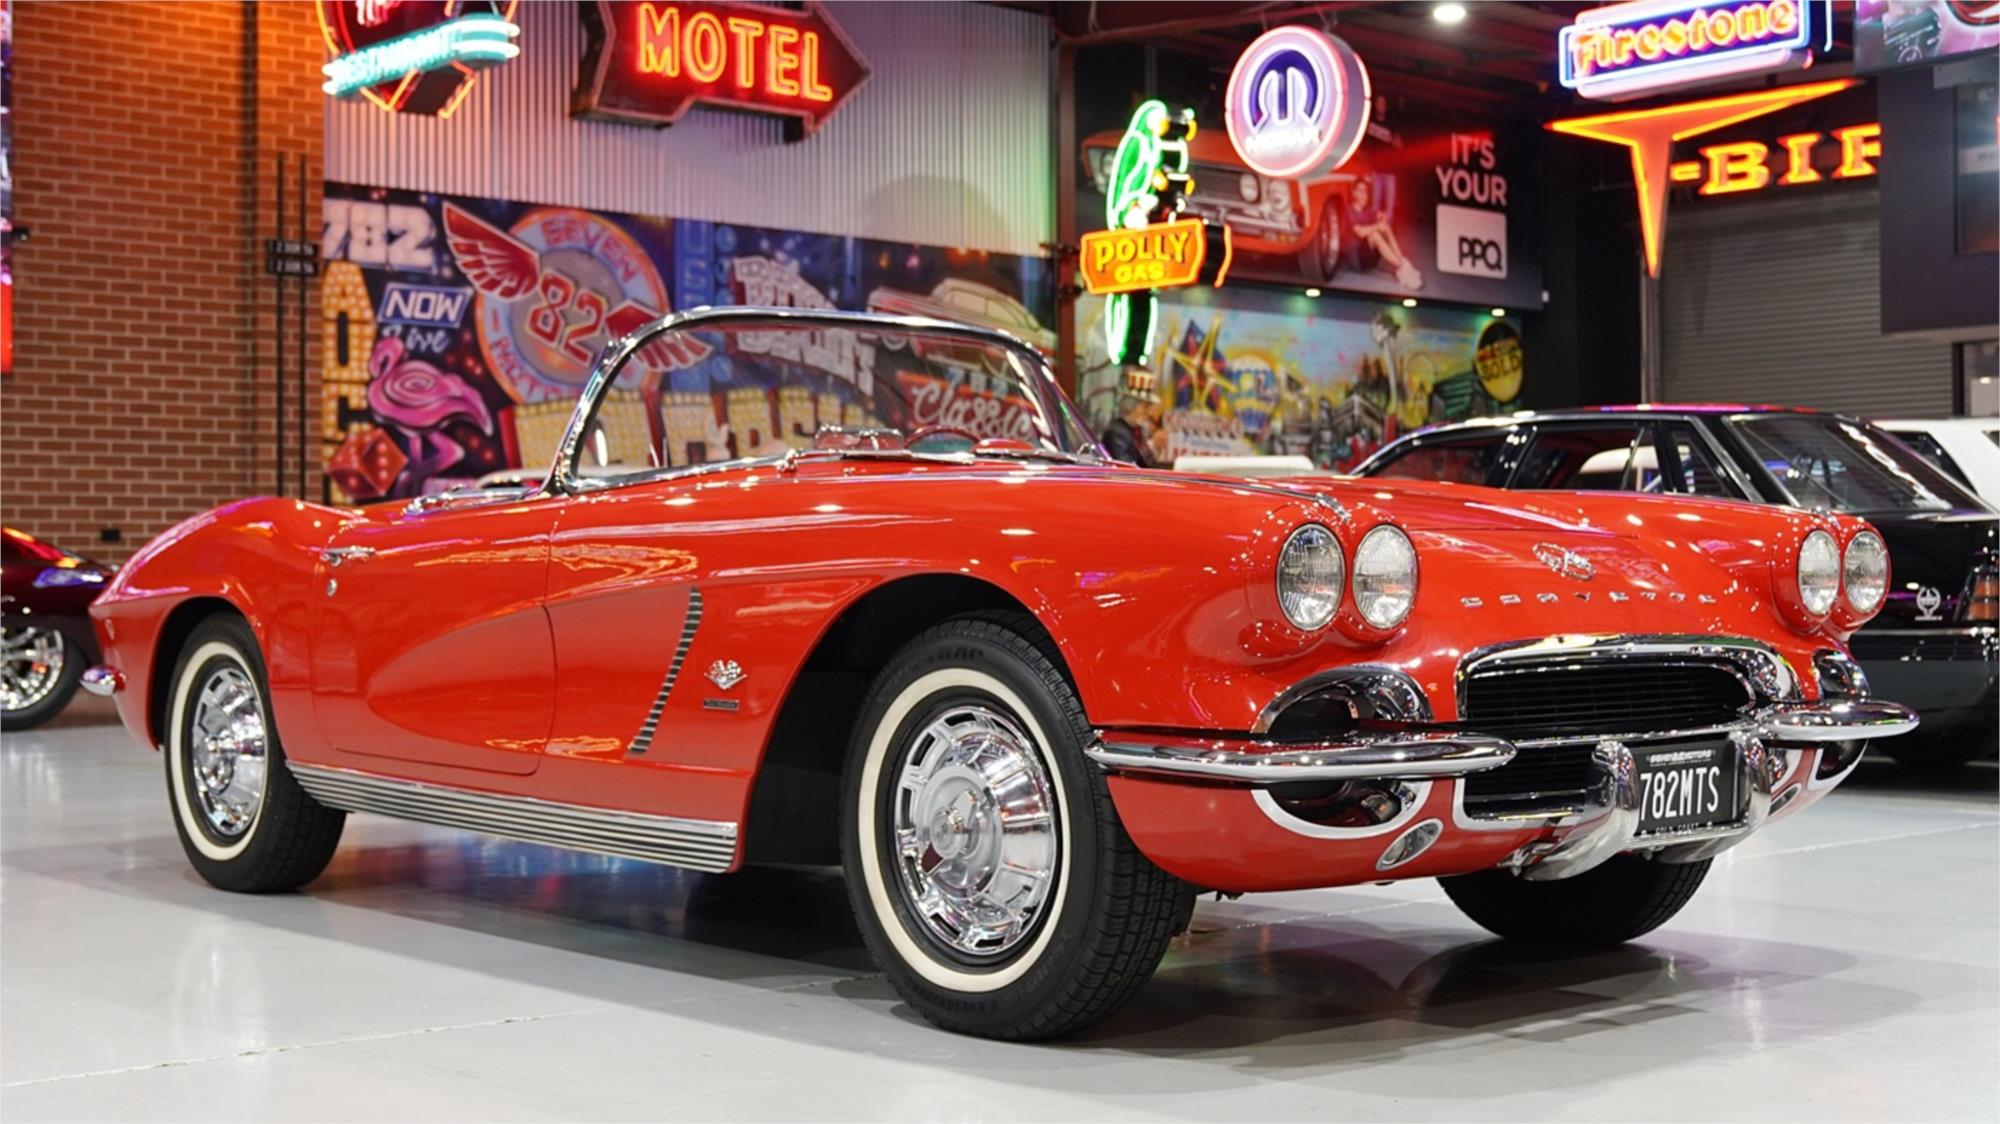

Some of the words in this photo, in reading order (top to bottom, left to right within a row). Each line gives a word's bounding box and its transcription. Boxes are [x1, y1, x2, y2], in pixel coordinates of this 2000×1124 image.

[638, 2, 833, 102] MOTEL
[1575, 0, 1798, 77] Firestone
[1451, 133, 1496, 169] IT'S
[1436, 165, 1507, 206] YOUR
[322, 199, 435, 268] 782
[541, 219, 637, 284] SEVEN
[1094, 231, 1190, 272] POLLY
[1458, 235, 1503, 272] PPQ
[1114, 261, 1165, 284] GAS
[384, 290, 465, 322] NOW
[527, 270, 610, 367] 82
[911, 381, 1031, 441] Classic
[1640, 766, 1720, 821] 782MTS
